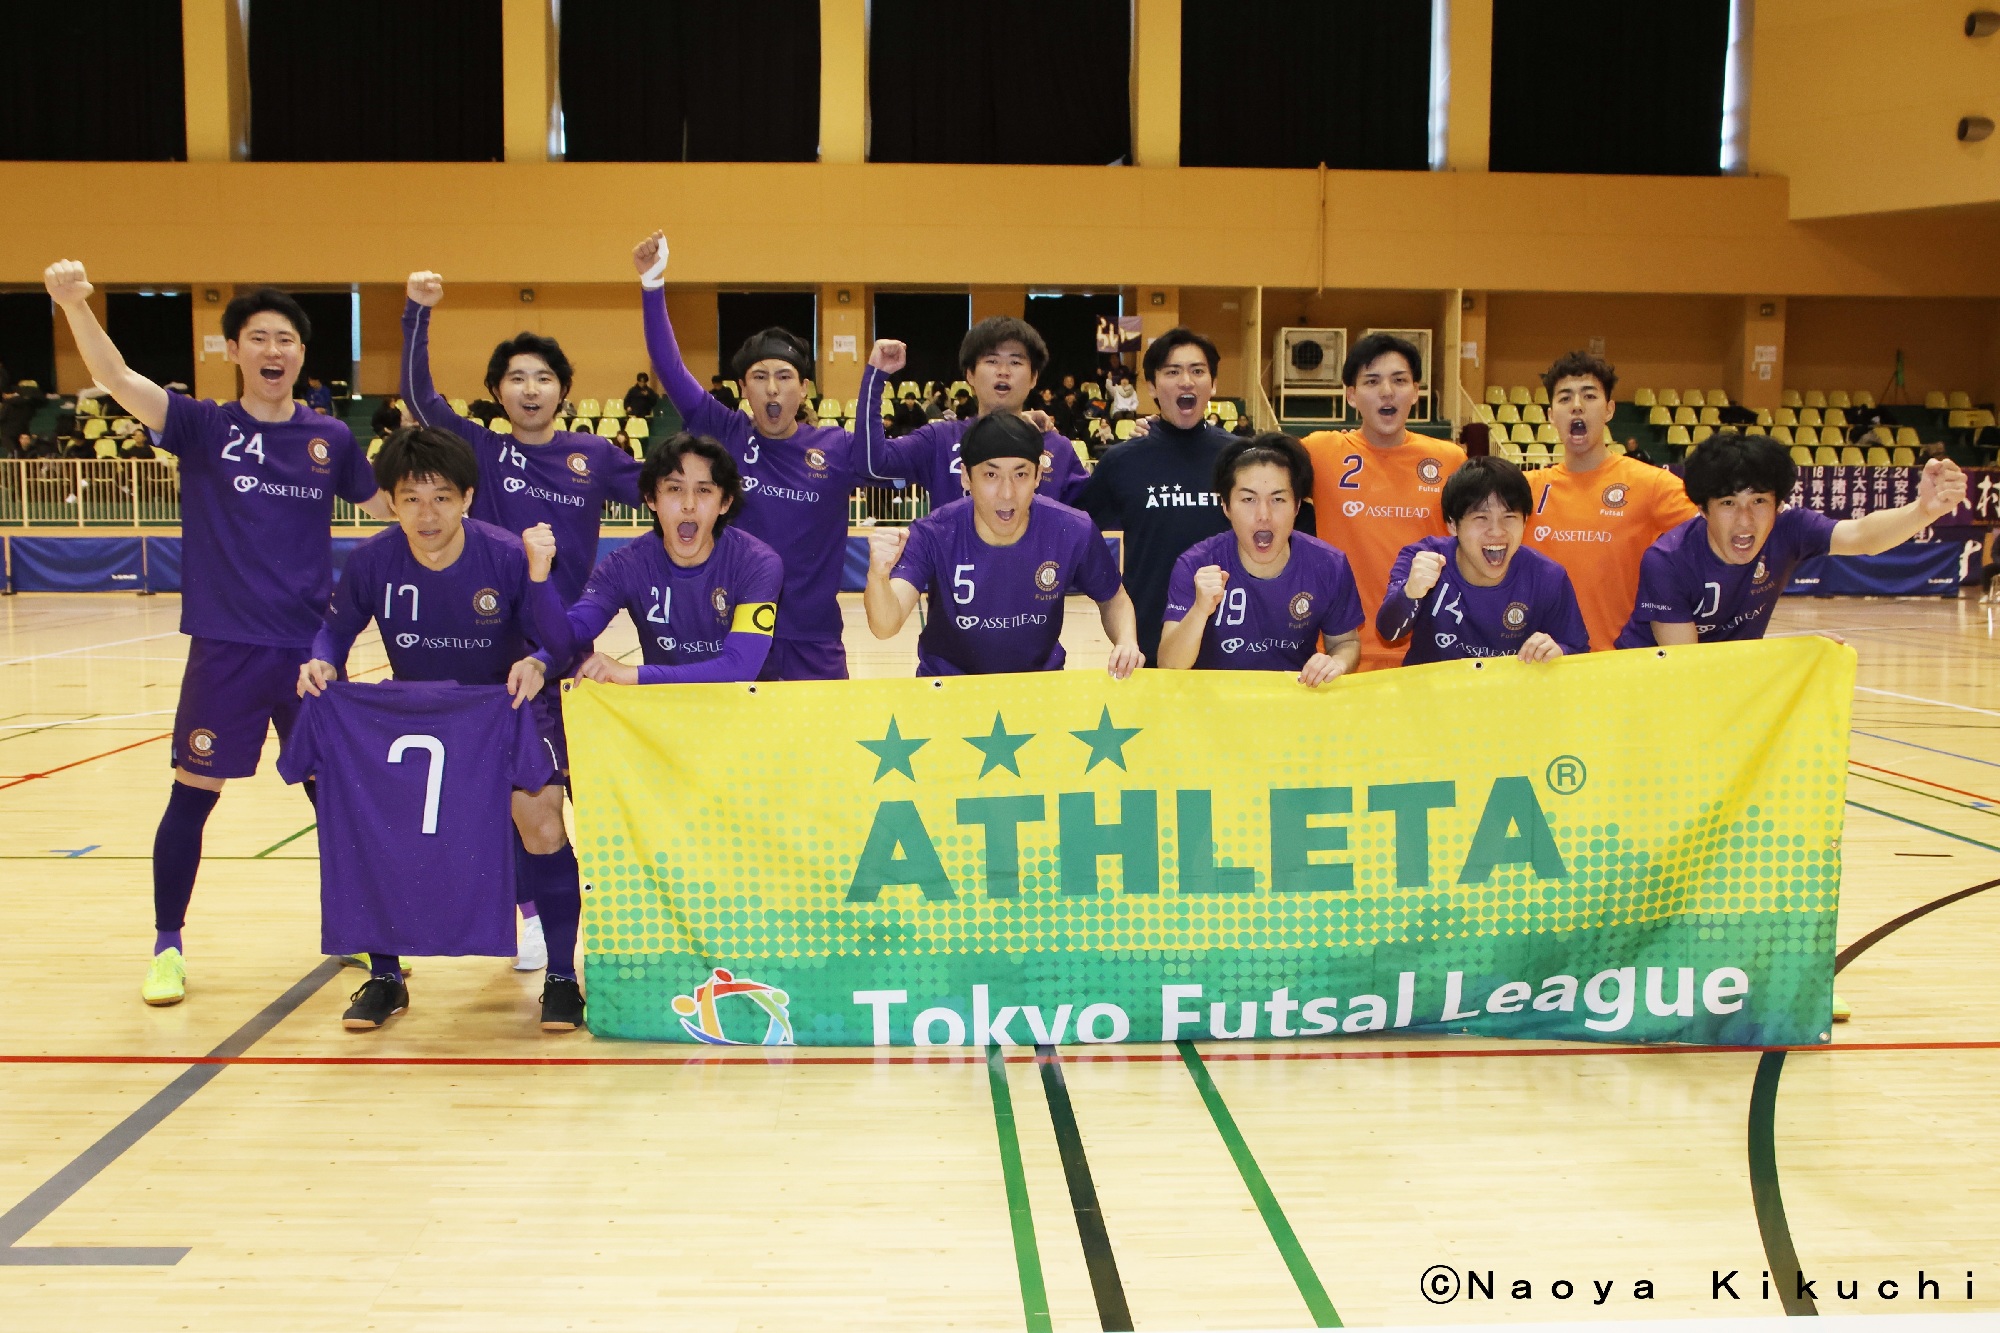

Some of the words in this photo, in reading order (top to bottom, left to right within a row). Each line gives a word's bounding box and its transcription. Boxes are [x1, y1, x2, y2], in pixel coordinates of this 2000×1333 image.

[221, 424, 265, 465] 24
[743, 435, 760, 465] 3
[1338, 453, 1364, 490] 2
[1812, 466, 1824, 478] 18
[1894, 467, 1909, 478] 24
[259, 482, 323, 500] ASSETLEAD
[525, 485, 585, 508] ASSETLEAD
[757, 484, 820, 503] ASSETLEAD
[1418, 485, 1441, 493] Futsal
[1810, 479, 1825, 513] 青木
[1145, 492, 1223, 509] ATHLET
[1536, 483, 1552, 515] 1
[1365, 505, 1430, 519] ASSETLEAD
[1599, 508, 1624, 517] Futsal
[1550, 529, 1612, 543] ASSETLEAD
[953, 564, 976, 605] 5
[384, 582, 419, 621] 17
[646, 586, 671, 624] 21
[1034, 592, 1059, 601] Futsal
[1215, 587, 1247, 627] 19
[475, 617, 502, 626] Futsal
[752, 604, 775, 632] C
[979, 613, 1049, 630] ASSETLEAD
[421, 637, 493, 650] ASSETLEAD
[678, 640, 724, 654] SSETLE
[1245, 637, 1305, 653] ASSTLEA
[386, 735, 445, 834] 7
[845, 776, 1569, 903] ATHLETA
[853, 984, 1130, 1046] Tokyo
[1162, 970, 1415, 1042] Futsal
[1441, 966, 1750, 1032] League
